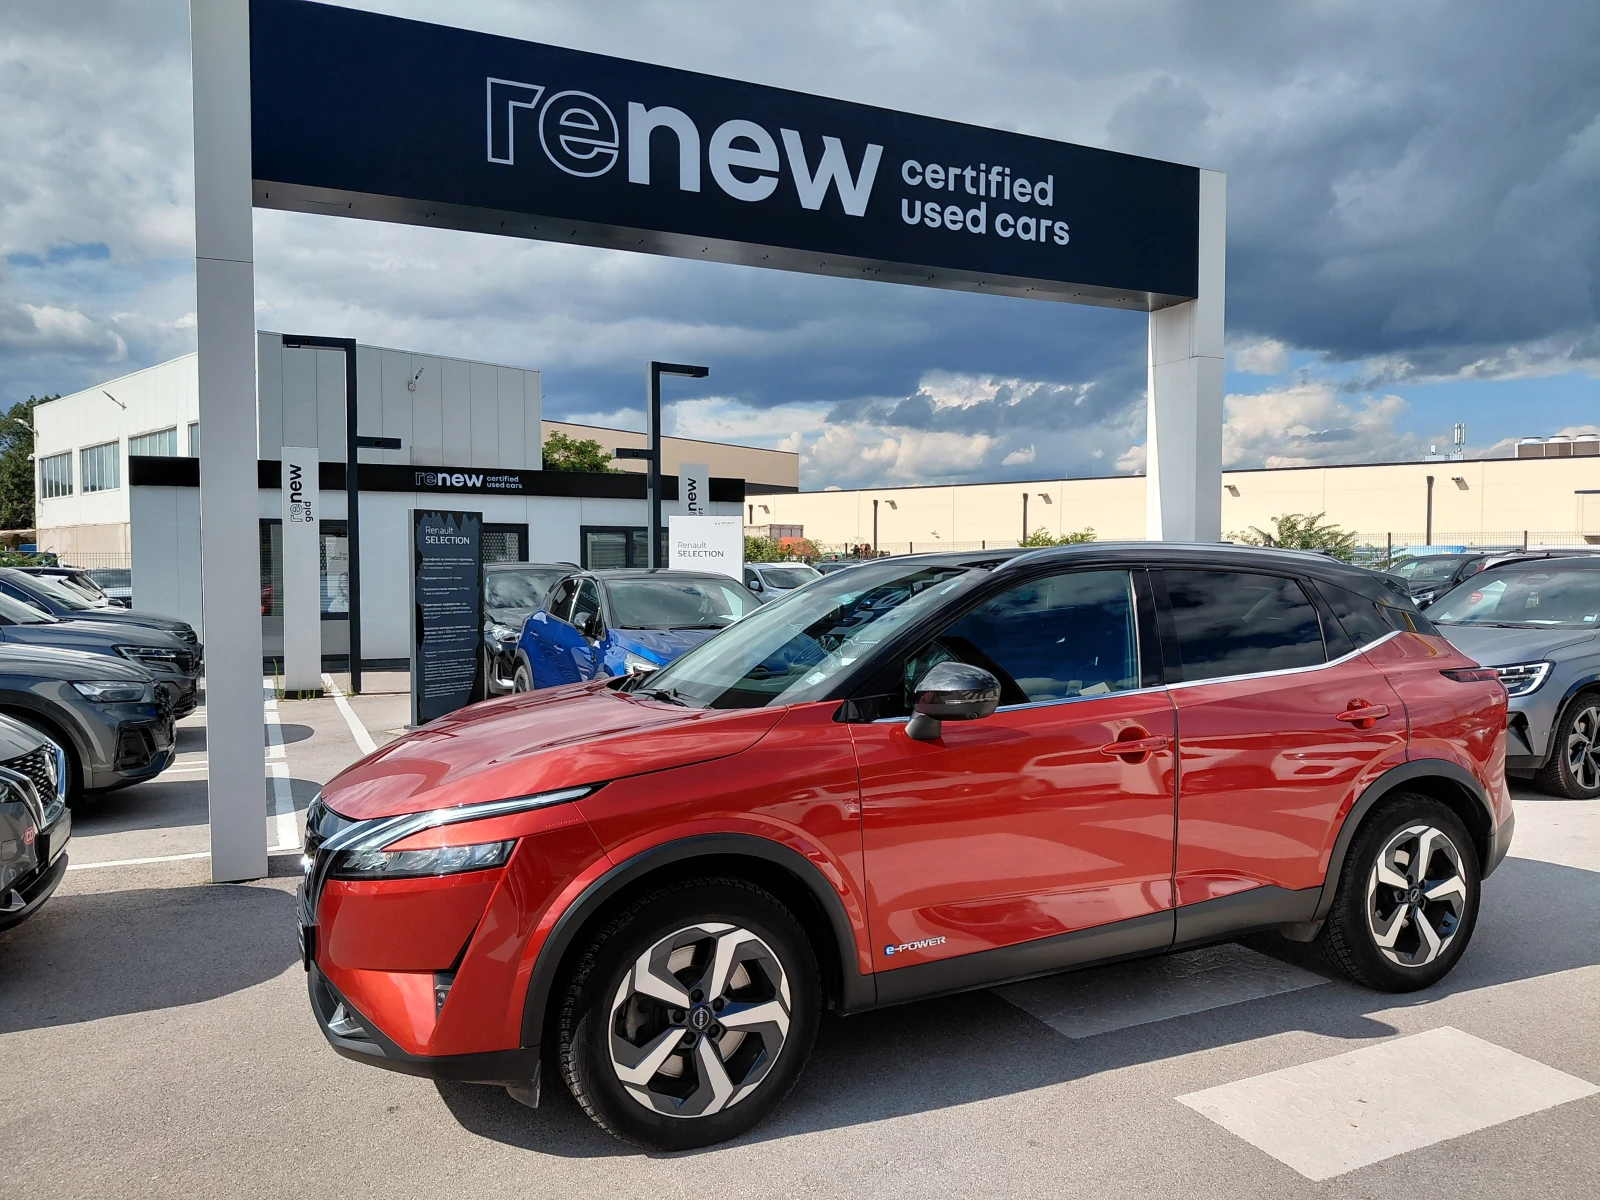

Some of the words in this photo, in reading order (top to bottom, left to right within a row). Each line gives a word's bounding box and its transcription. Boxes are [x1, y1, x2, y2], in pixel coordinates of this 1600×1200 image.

[486, 77, 884, 218] renew
[901, 159, 1055, 207] certified
[901, 198, 987, 236] used
[995, 213, 1071, 248] cars
[415, 472, 484, 487] renew
[486, 475, 519, 483] certified
[290, 464, 303, 523] renew
[303, 501, 314, 523] gold
[425, 526, 454, 535] Renault
[425, 536, 470, 545] SELECTION
[677, 541, 707, 549] Renault
[677, 550, 724, 558] SELECTION
[884, 936, 947, 956] e-POWER
